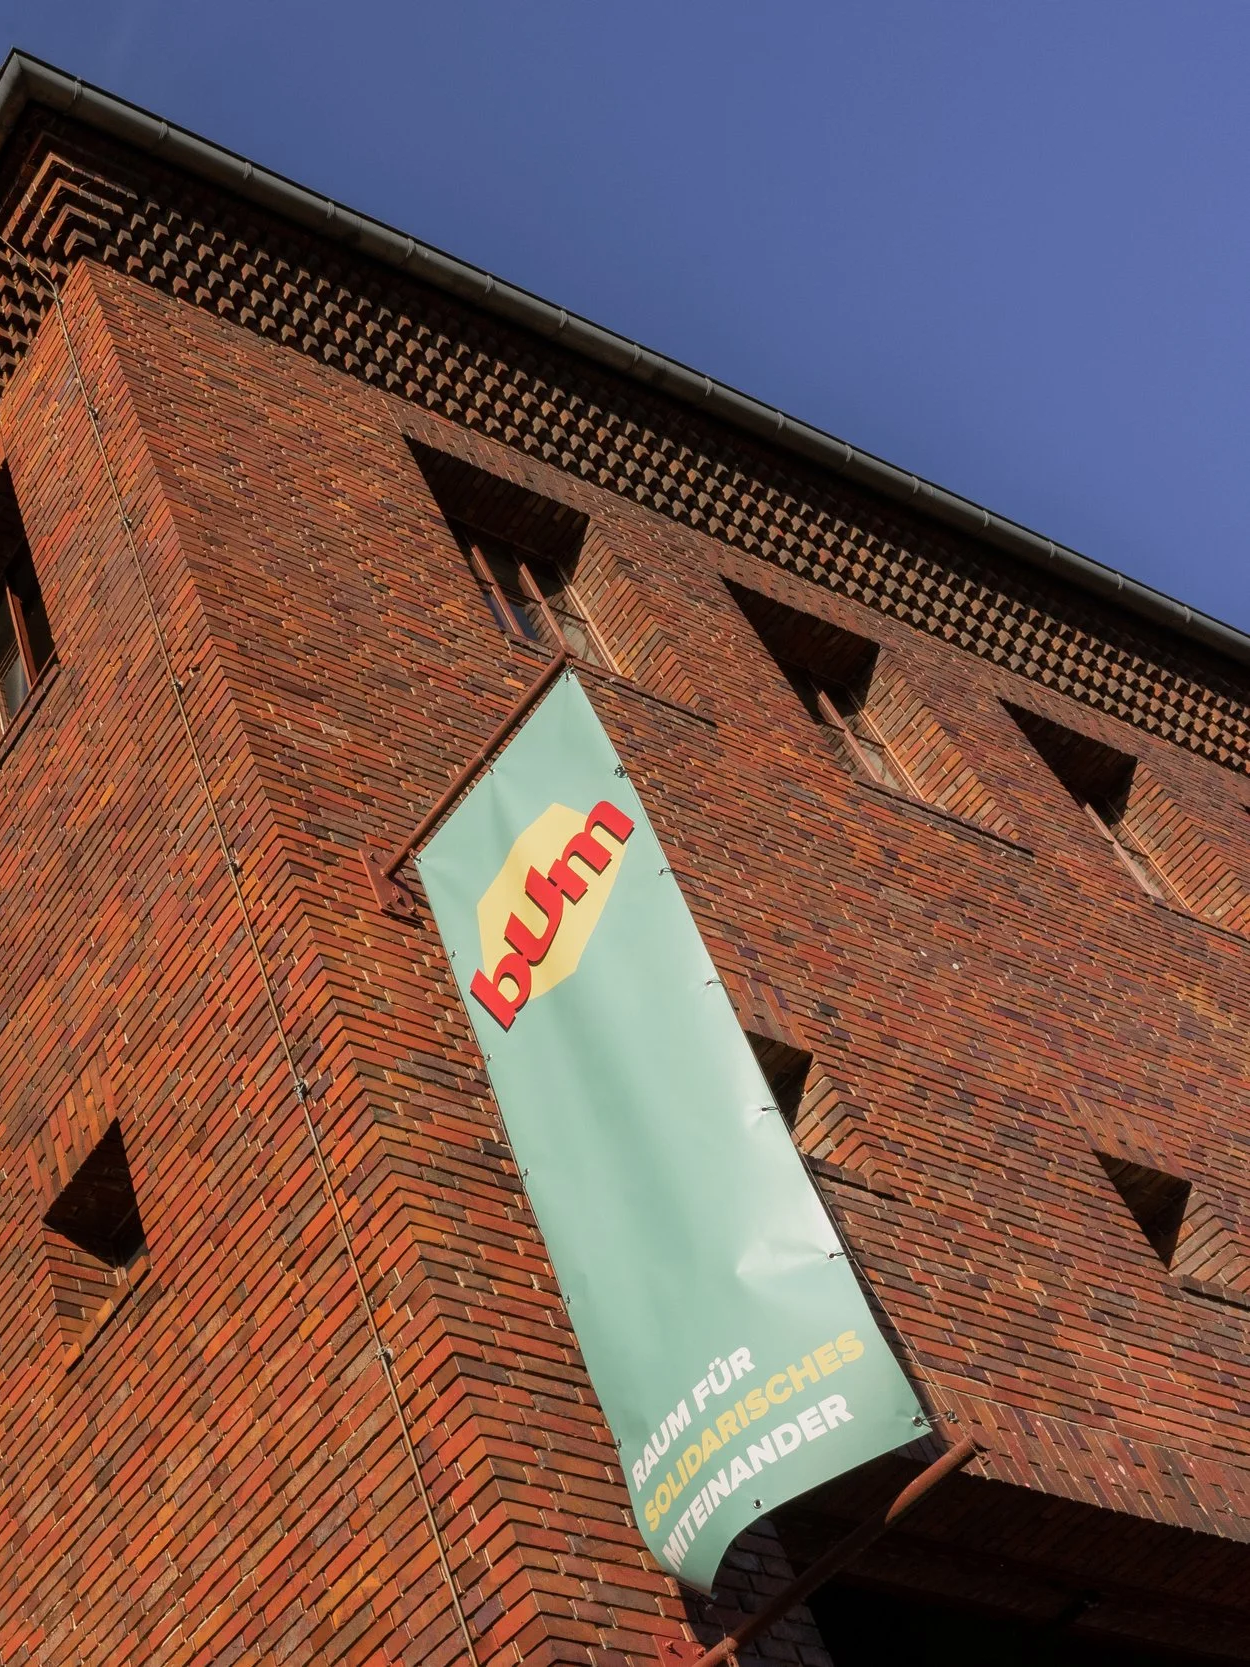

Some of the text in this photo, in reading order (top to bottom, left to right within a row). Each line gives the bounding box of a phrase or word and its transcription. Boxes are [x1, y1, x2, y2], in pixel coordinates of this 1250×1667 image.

[632, 1347, 756, 1492] RAUM FÜR
[644, 1330, 865, 1531] SOLIDARISCHES
[662, 1394, 854, 1574] MITEINANDER
